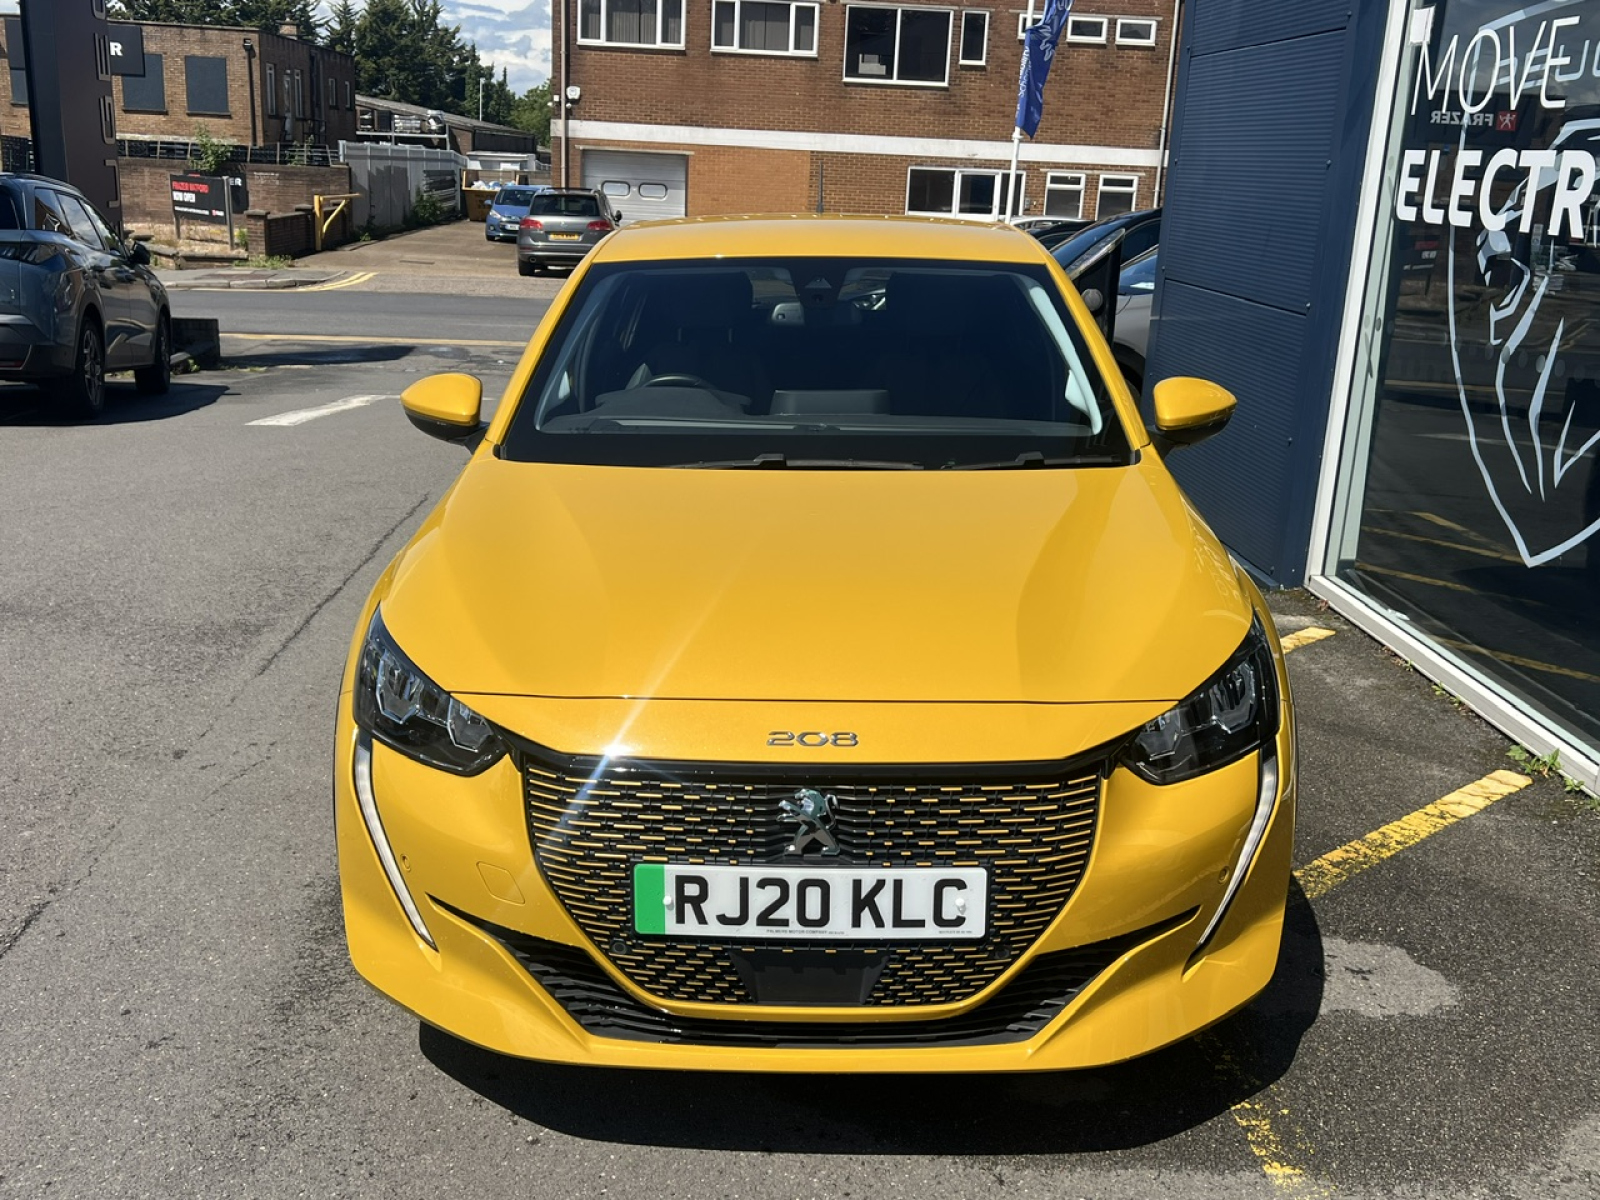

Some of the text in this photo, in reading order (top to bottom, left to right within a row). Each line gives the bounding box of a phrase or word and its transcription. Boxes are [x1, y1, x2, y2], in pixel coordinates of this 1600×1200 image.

[1411, 16, 1580, 115] MOVE
[1396, 148, 1595, 239] ELECTR
[766, 731, 859, 747] 208
[674, 874, 968, 929] RJ20 KLC
